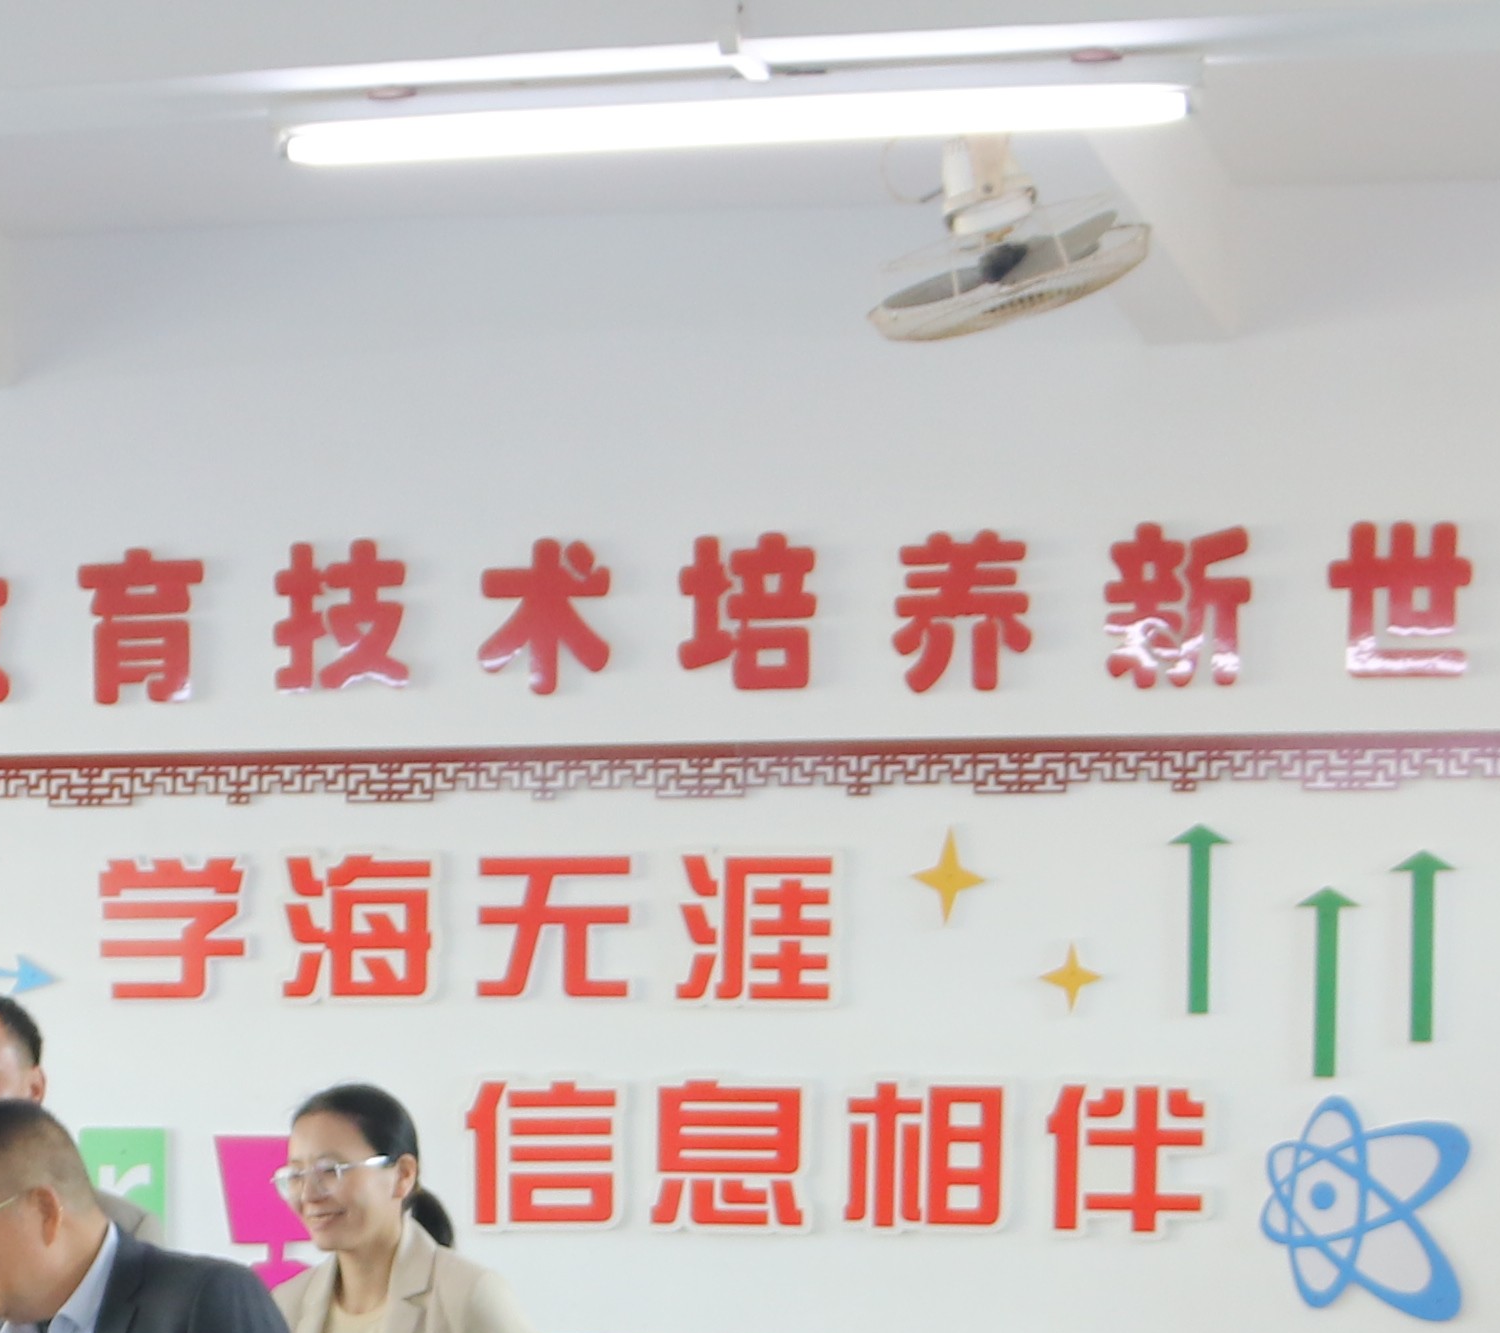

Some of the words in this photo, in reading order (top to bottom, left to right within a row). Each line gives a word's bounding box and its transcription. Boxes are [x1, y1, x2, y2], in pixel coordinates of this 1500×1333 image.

[98, 852, 836, 1004] 学海无涯
[464, 1078, 1207, 1235] 信息相伴
